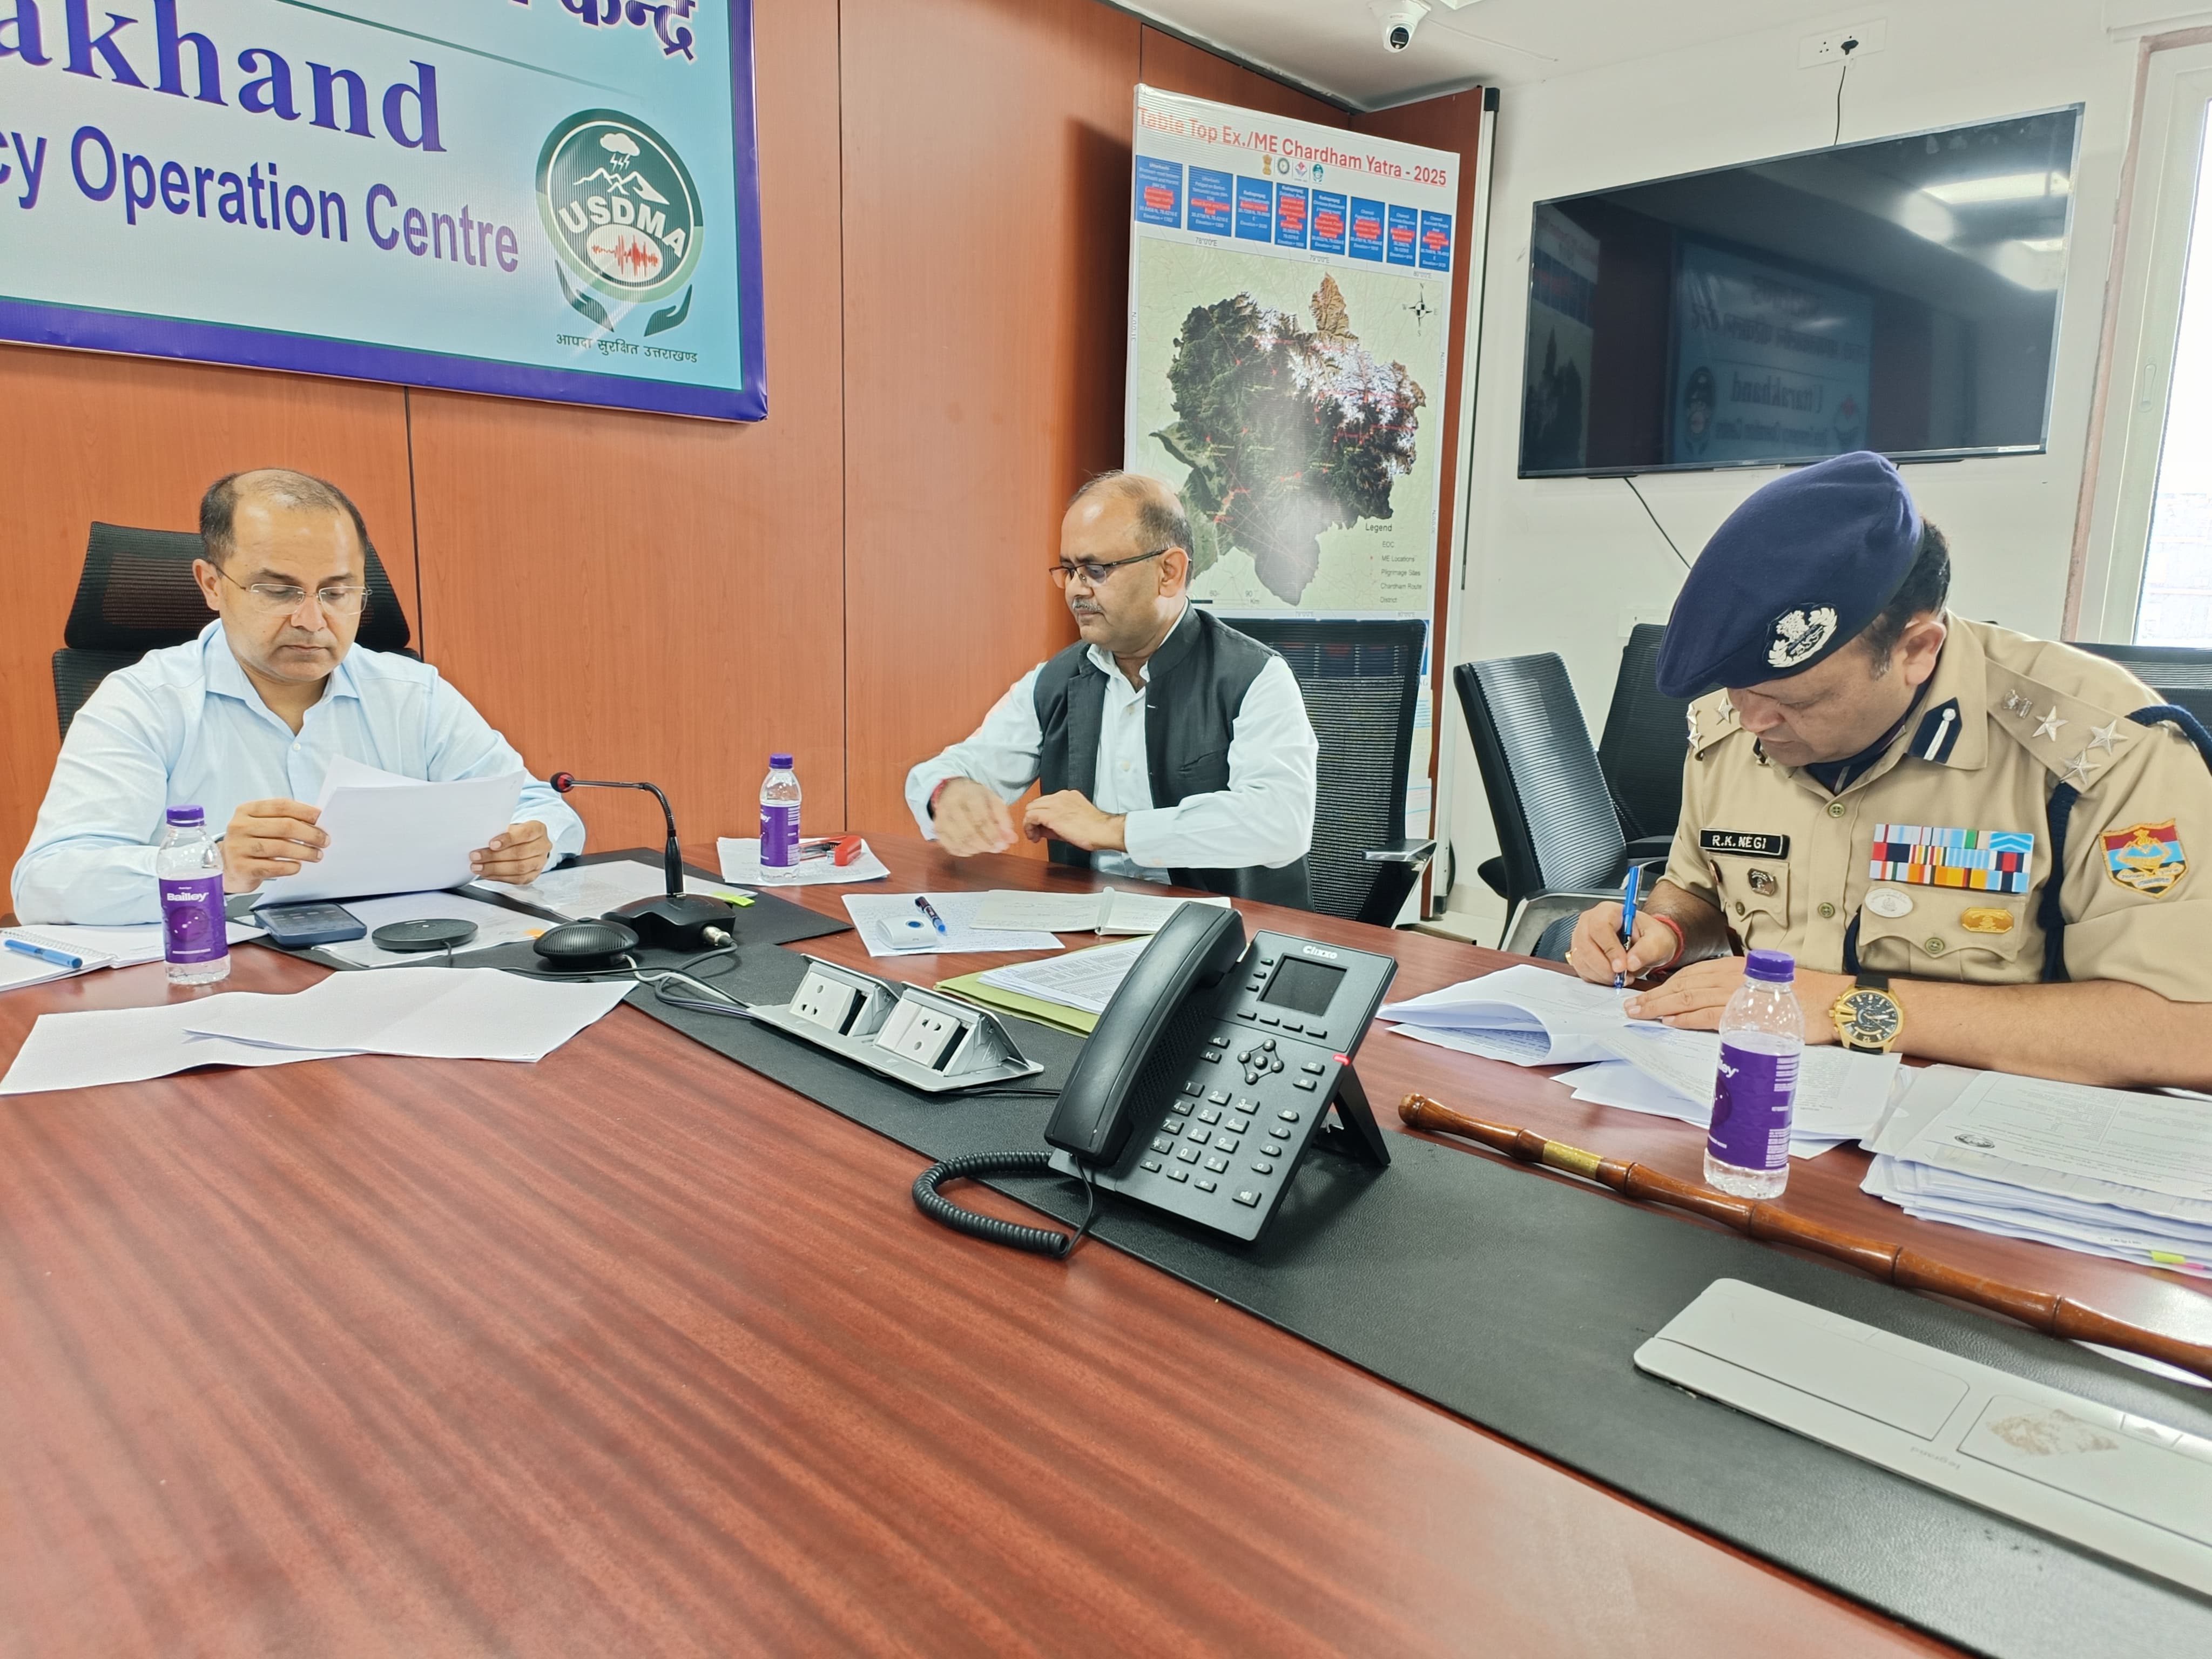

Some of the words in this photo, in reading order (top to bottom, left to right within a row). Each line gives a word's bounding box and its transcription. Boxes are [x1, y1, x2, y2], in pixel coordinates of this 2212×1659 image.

[0, 0, 447, 152] akhand
[1137, 106, 1184, 134] Table
[1189, 118, 1217, 144] Top
[1223, 125, 1278, 153] Ex./ME
[1282, 138, 1361, 170] Chardham
[1366, 155, 1402, 178] Yatra
[1414, 166, 1447, 186] 2025
[71, 126, 348, 242] Operation
[366, 183, 518, 272] Centre
[558, 195, 686, 258] USDMA
[556, 334, 592, 348] आपदा
[597, 339, 639, 356] सुरक्षित
[643, 346, 698, 363] उत्तराखण्ड
[1365, 523, 1392, 533] Legend
[1738, 836, 1767, 849] NEGI
[167, 892, 209, 902] Bailley
[1185, 1082, 1191, 1091] 1
[1211, 1090, 1219, 1099] 2
[1238, 1098, 1246, 1107] 3
[1174, 1101, 1182, 1110] 4
[1228, 1118, 1236, 1127] 6
[1163, 1119, 1171, 1128] 7
[1191, 1128, 1198, 1137] 8
[1218, 1137, 1226, 1146] 9
[1180, 1148, 1188, 1157] 0
